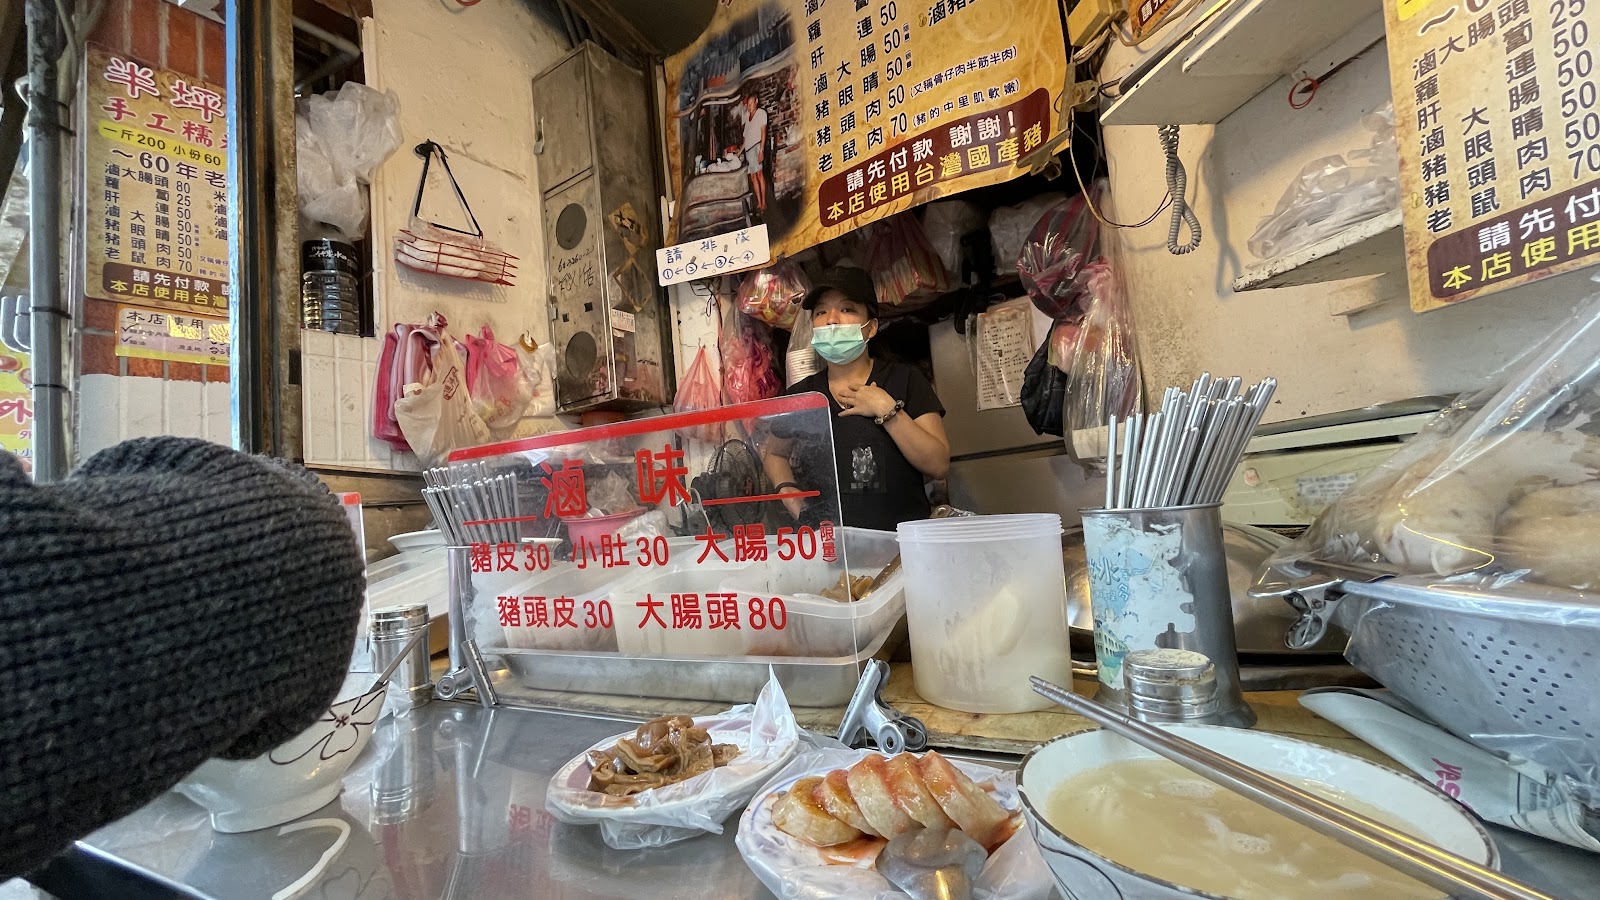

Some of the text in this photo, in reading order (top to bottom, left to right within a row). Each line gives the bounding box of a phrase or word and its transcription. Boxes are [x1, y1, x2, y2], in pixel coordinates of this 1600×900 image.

[811, 16, 874, 70] 肝連
[881, 1, 897, 26] 50
[1412, 0, 1531, 81] 滷大腸頭
[1549, 0, 1586, 30] 25
[104, 57, 226, 123] 半坪
[814, 43, 876, 95] 滷大腸
[884, 29, 901, 54] 50
[815, 71, 879, 120] 豬眼睛
[887, 56, 904, 81] 50
[1416, 20, 1588, 132] 肝連 50
[816, 98, 881, 147] 豬頭肉
[888, 85, 904, 109] 50
[1419, 50, 1593, 157] 滷大腸 50
[1421, 80, 1597, 182] 豬眼睛 50
[818, 127, 883, 173] 老鼠肉
[890, 112, 907, 138] 70
[826, 120, 1043, 222] 本店使用台灣國產豬
[845, 138, 933, 193] 請先付款
[1423, 112, 1600, 209] 豬頭肉 50
[104, 162, 191, 194] 滷大腸頭 80
[104, 189, 191, 220] 肝連 50
[176, 193, 191, 207] 25
[1426, 166, 1551, 234] 老鼠肉
[104, 203, 192, 233] 滷大腸 50
[104, 218, 170, 242] 豬眼睛
[177, 233, 192, 246] 50
[104, 232, 171, 256] 豬頭肉
[177, 247, 192, 260] 50
[1477, 187, 1600, 254] 請先付
[104, 246, 171, 269] 老鼠肉
[178, 259, 193, 273] 70
[132, 268, 210, 293] 請先付款
[1441, 222, 1600, 290] 本店使用
[540, 443, 692, 520] 滷味
